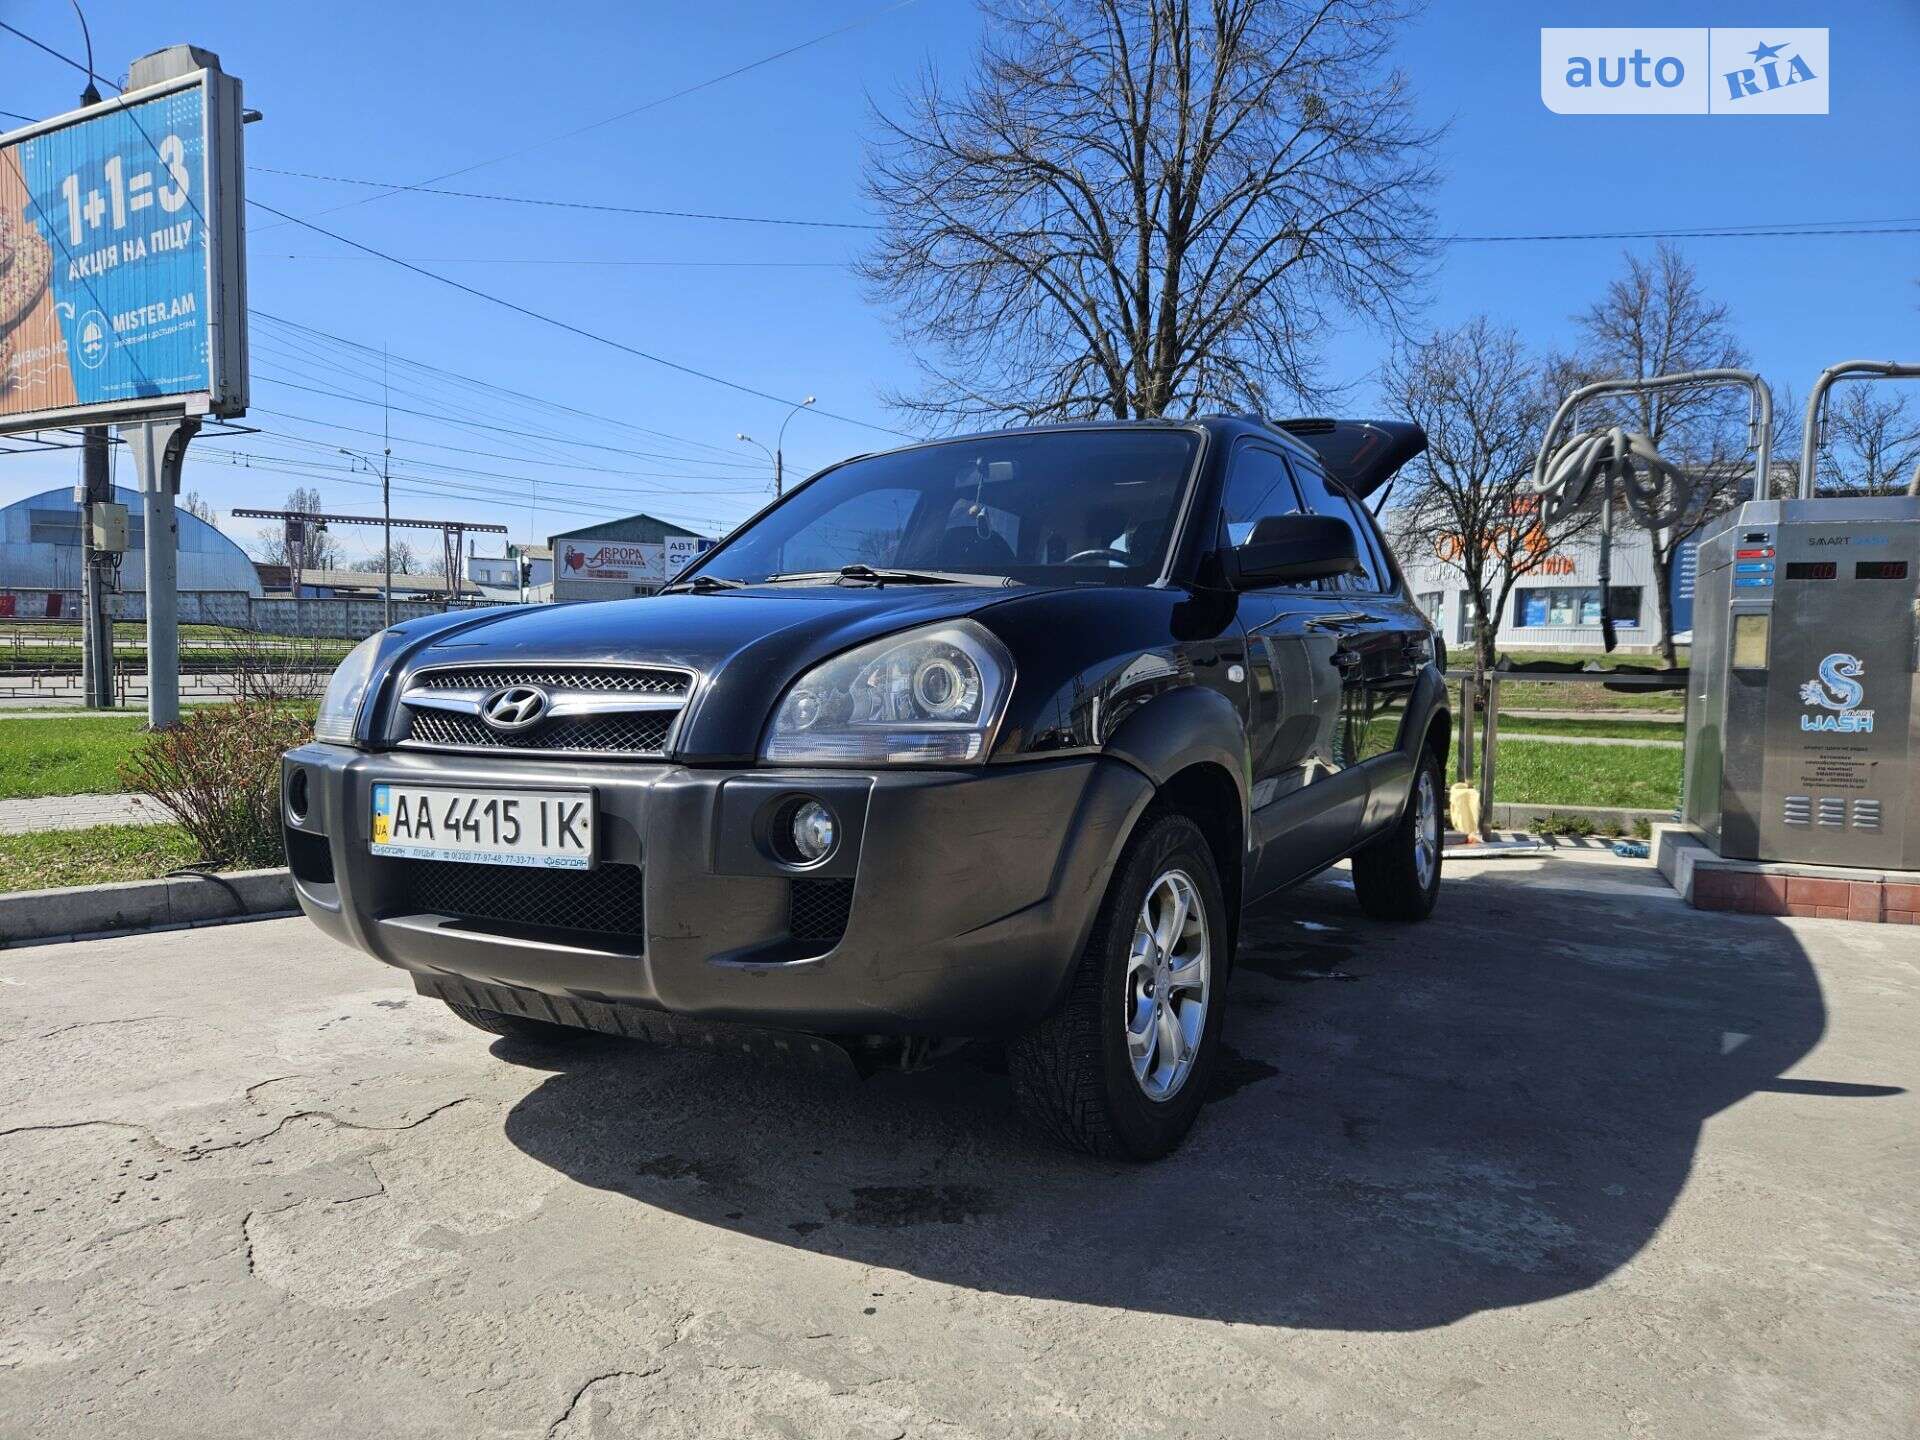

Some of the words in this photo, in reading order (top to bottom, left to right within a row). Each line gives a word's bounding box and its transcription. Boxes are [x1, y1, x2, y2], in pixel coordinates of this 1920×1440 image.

[62, 134, 190, 246] 1+1=3
[68, 244, 119, 282] АКЦІЯ
[122, 236, 148, 262] НА
[150, 219, 193, 254] ПІЦУ
[112, 291, 196, 333] MISTER.AM
[670, 542, 696, 551] АВТ
[1808, 536, 1852, 546] SMART
[1801, 714, 1874, 733] WASH
[375, 824, 388, 837] UA
[393, 795, 436, 840] AA
[443, 797, 522, 844] 4415
[540, 800, 585, 849] IK
